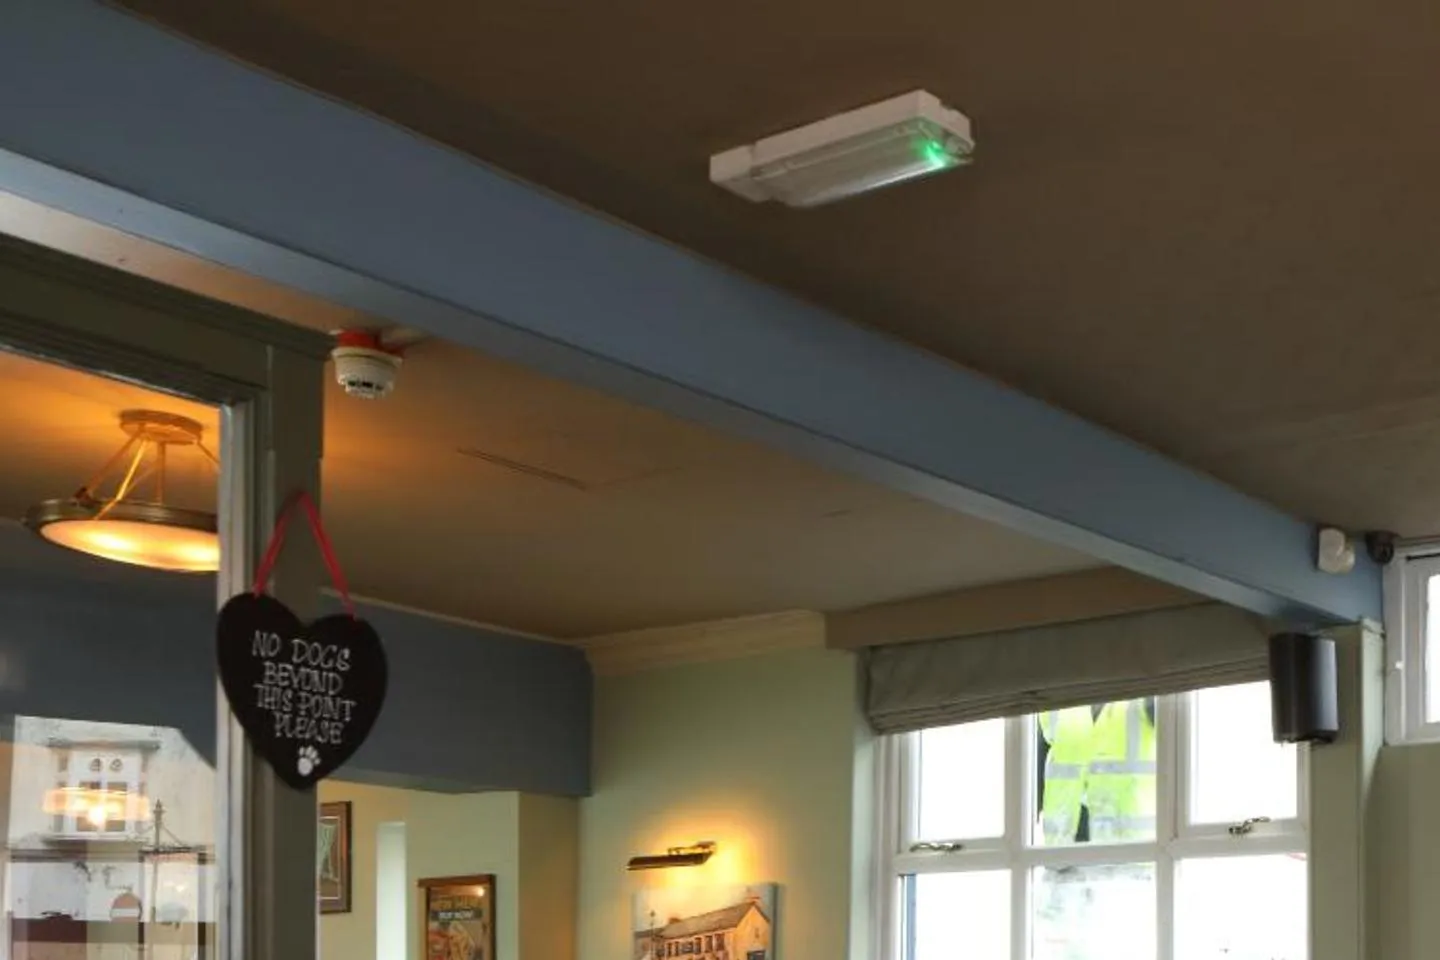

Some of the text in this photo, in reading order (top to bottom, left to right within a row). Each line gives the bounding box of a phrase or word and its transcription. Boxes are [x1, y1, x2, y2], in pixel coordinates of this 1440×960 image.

[252, 630, 350, 671] NO DOGS
[263, 661, 342, 695] BEYOND
[253, 683, 357, 721] THIS POINT
[274, 711, 344, 744] PLEASE
